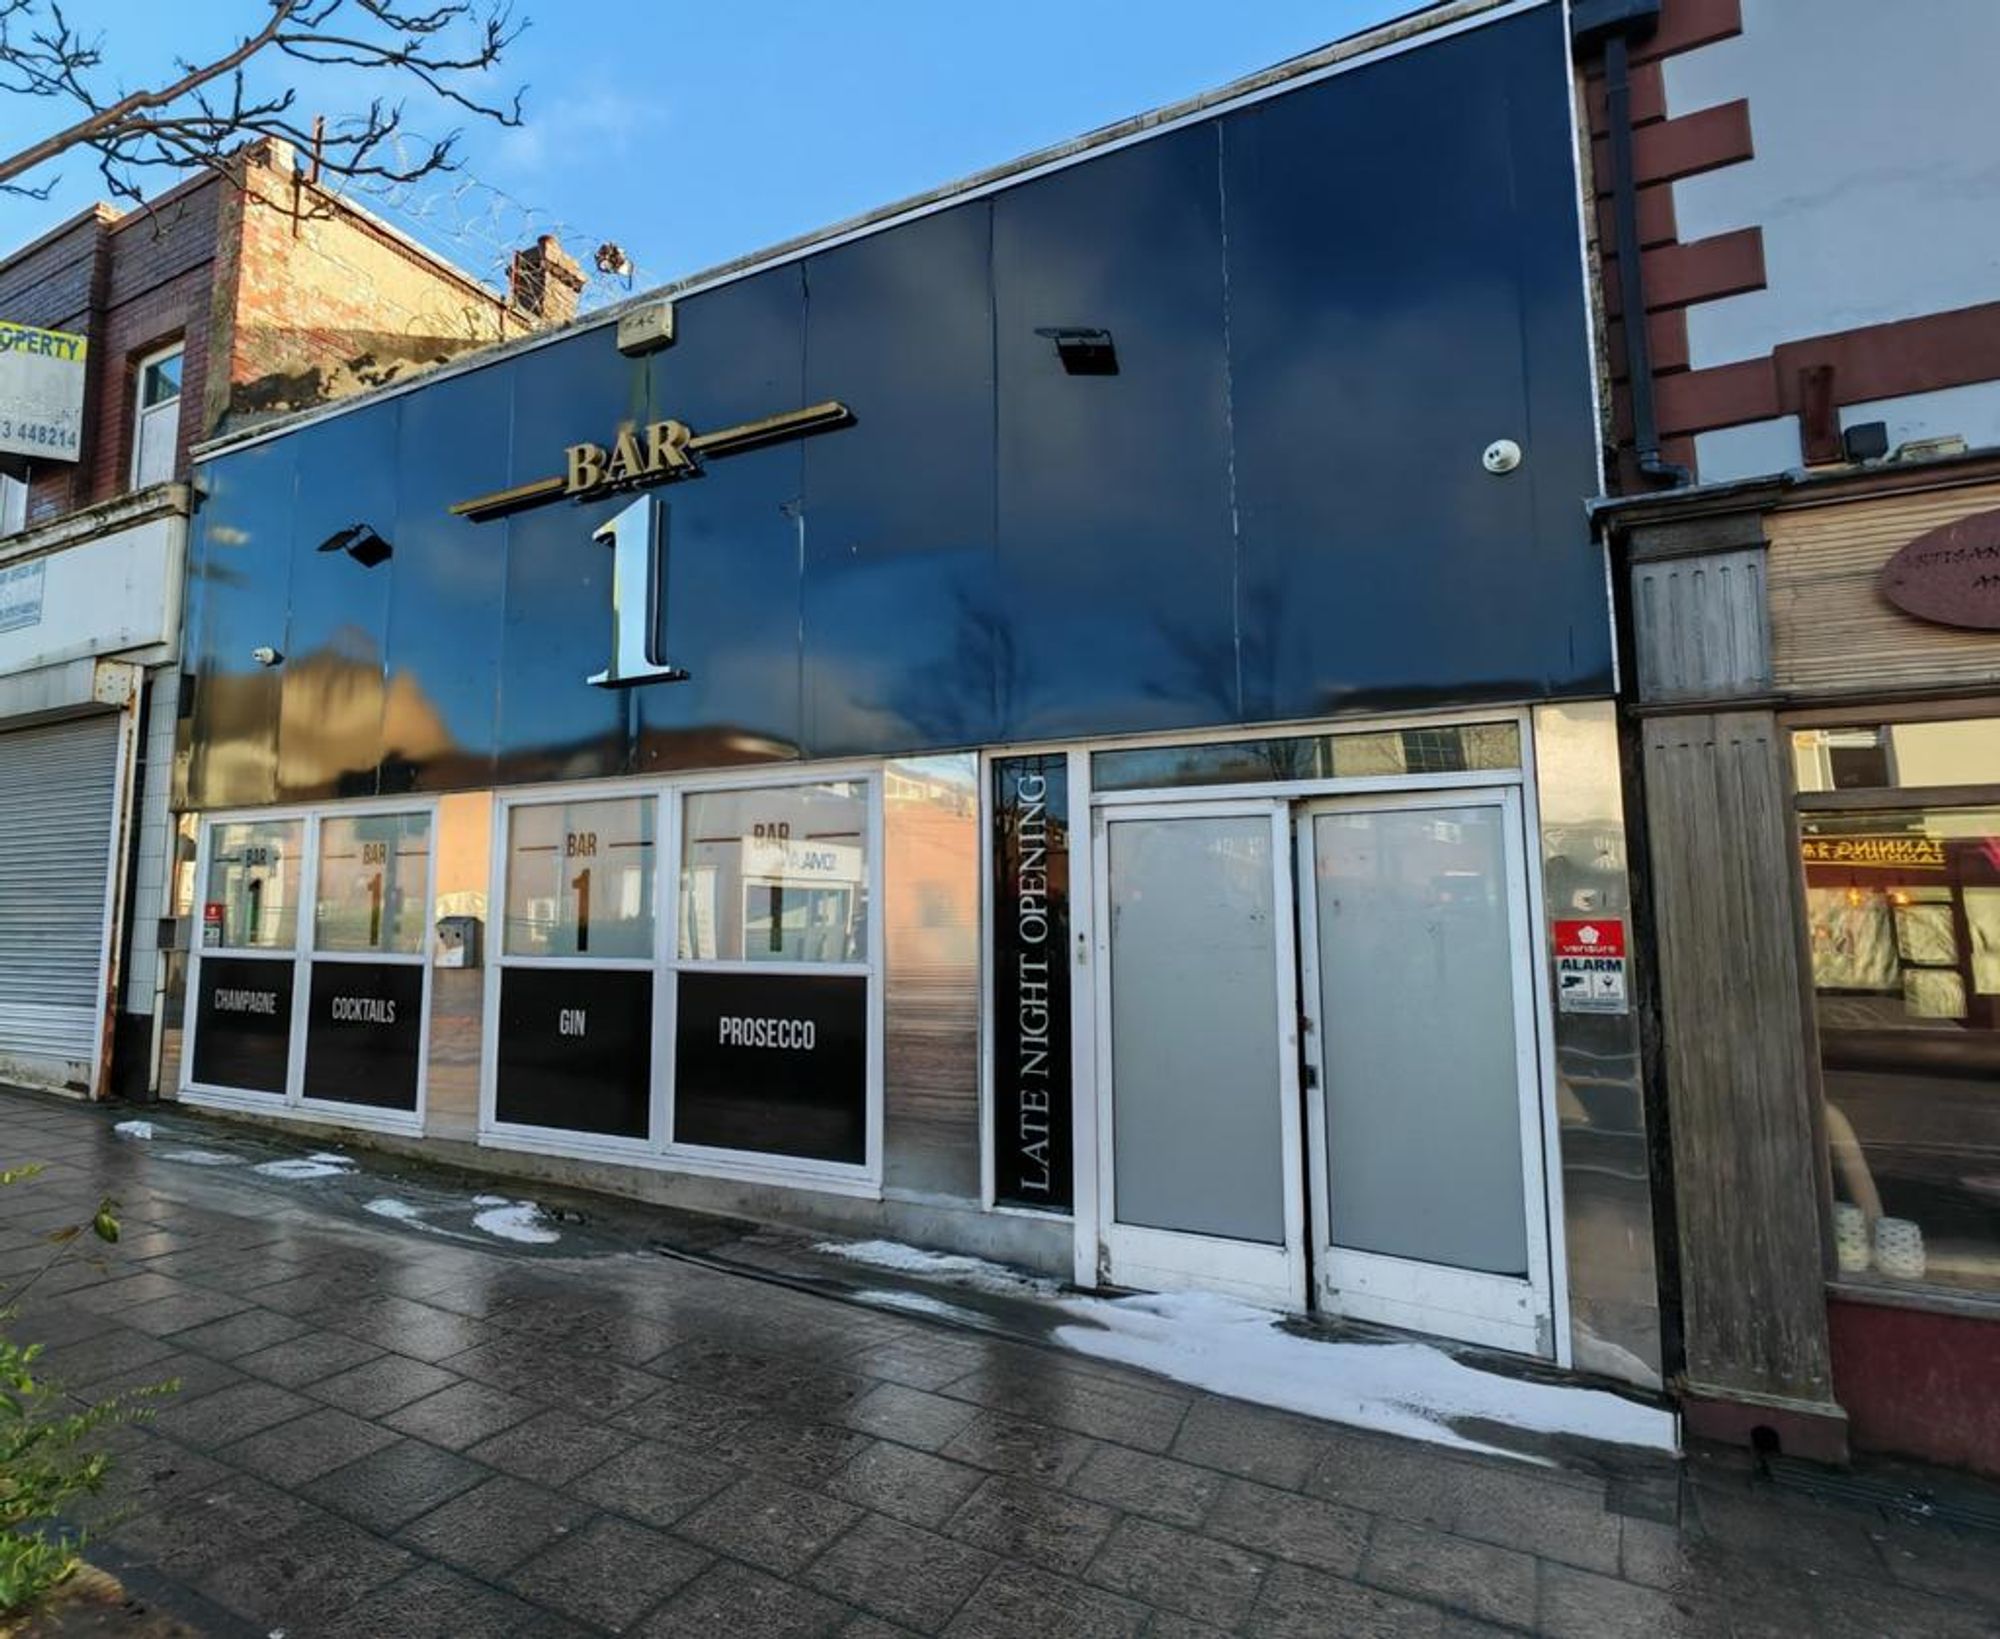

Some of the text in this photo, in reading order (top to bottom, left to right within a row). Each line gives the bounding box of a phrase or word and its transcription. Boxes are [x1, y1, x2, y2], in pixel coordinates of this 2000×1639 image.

[18, 423, 77, 448] 448214
[563, 418, 697, 494] BAR
[586, 494, 680, 688] 1
[566, 831, 598, 858] BAR
[753, 821, 791, 852] BAR
[246, 847, 268, 868] BAR
[363, 843, 387, 865] BAR
[248, 878, 262, 943] 1
[367, 872, 382, 946] 1
[572, 868, 590, 952] 1
[1560, 958, 1623, 972] ALARM
[1018, 774, 1050, 1192] LATE NIGHT OPENING
[214, 988, 277, 1015] CHAMPAGNE
[332, 996, 396, 1023] COCKTAILS
[559, 1009, 586, 1036] GIN
[718, 1016, 816, 1050] PROSECCO
